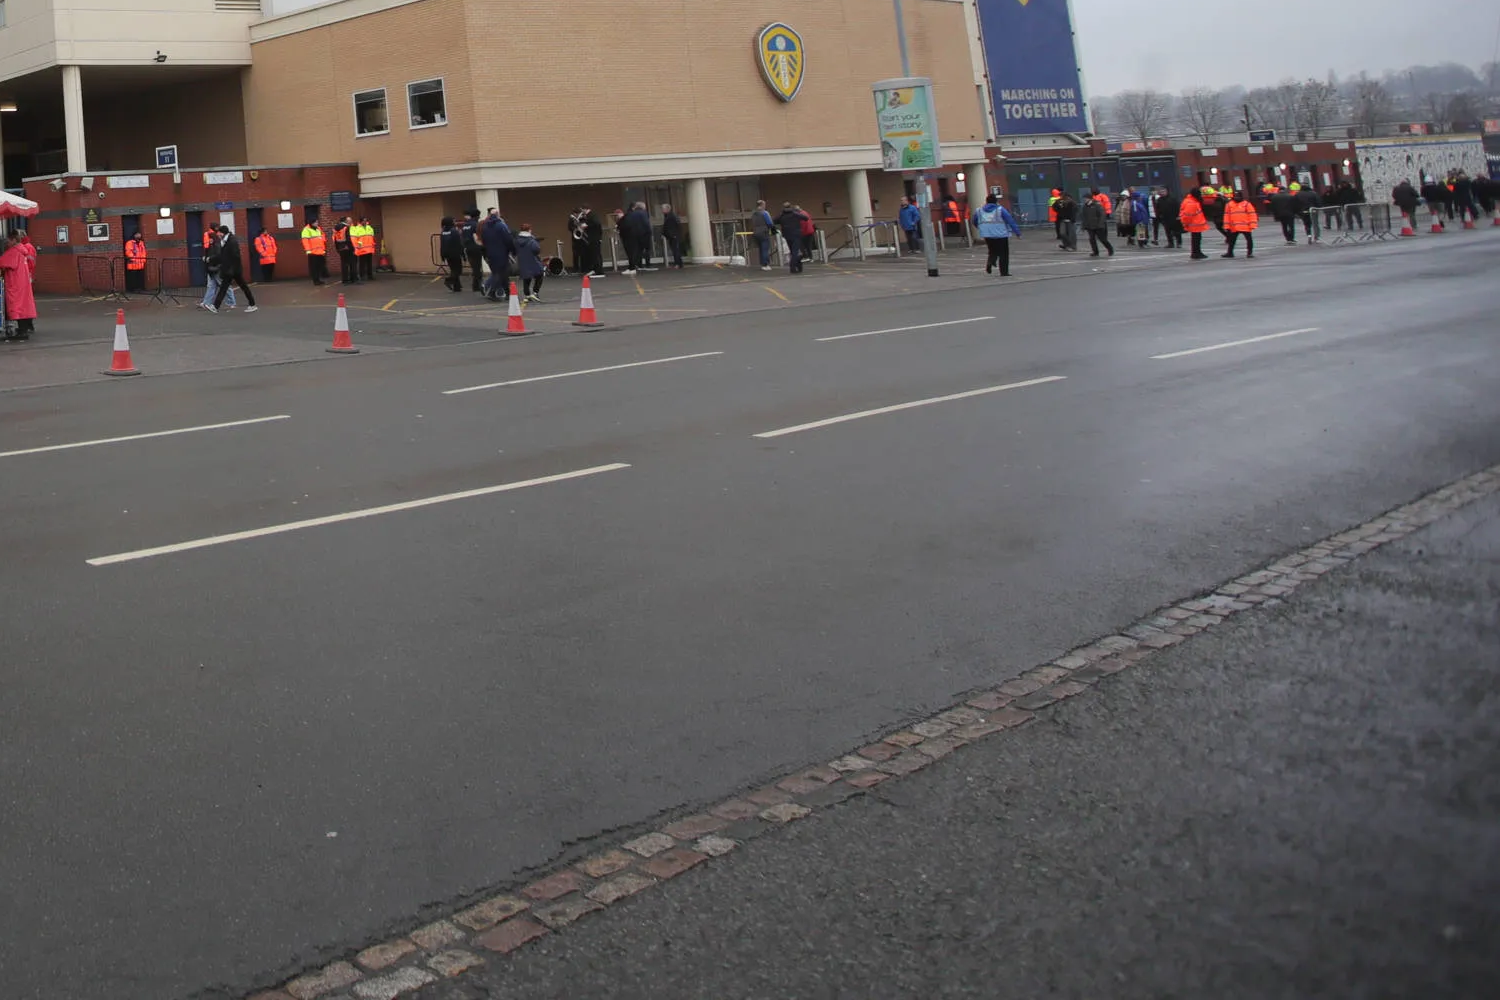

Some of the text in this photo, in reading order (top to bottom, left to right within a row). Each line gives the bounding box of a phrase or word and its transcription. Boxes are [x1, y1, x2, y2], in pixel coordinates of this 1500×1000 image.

[1001, 87, 1075, 100] MARCHING ON
[1002, 102, 1078, 120] TOGETHER
